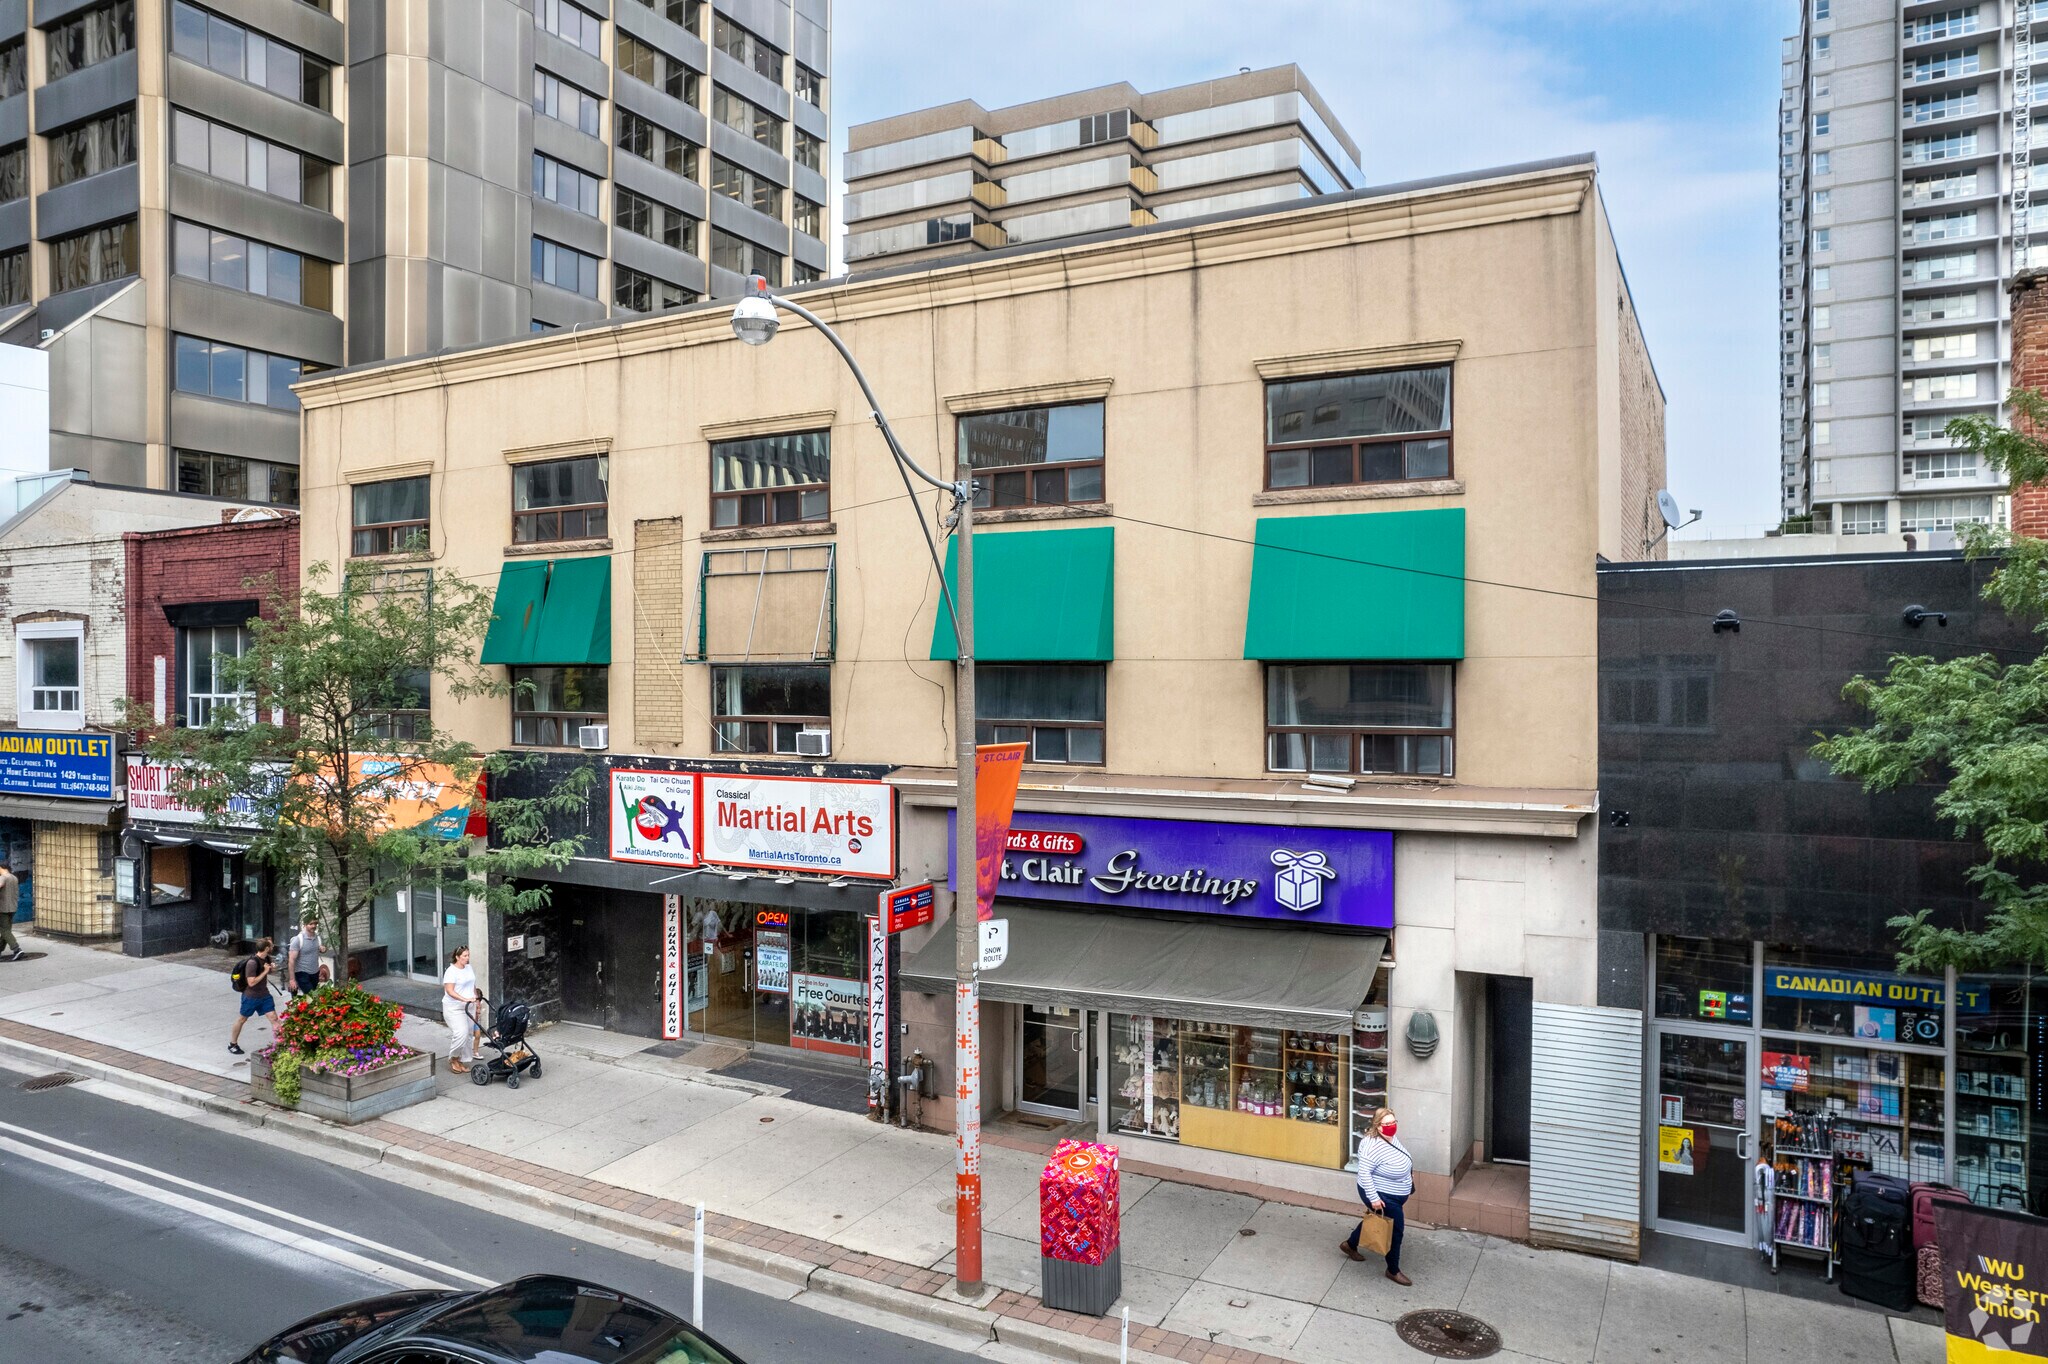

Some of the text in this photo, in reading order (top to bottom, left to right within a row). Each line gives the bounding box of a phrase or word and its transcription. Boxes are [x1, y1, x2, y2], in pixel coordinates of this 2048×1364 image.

[46, 738, 108, 757] OUTLET
[984, 752, 1020, 762] ST. CLAIR
[61, 770, 76, 779] 1429
[128, 764, 161, 791] SHORT
[130, 793, 149, 808] FULLY
[716, 790, 750, 800] Classical
[718, 802, 874, 837] Martial Arts
[1030, 834, 1039, 849] &
[1043, 835, 1074, 850] Gifts
[749, 849, 841, 864] MartialArtsToronto.ca
[1022, 858, 1084, 884] Clair
[1090, 850, 1257, 905] Greetings
[757, 911, 789, 924] OPEN
[668, 926, 677, 958] CHUAN
[985, 946, 1002, 955] SNOW
[983, 955, 1002, 963] ROUTE
[668, 973, 676, 996] CHI
[799, 986, 823, 999] Free
[872, 938, 884, 1049] KARATE
[1776, 975, 1882, 997] CANADIAN
[668, 1001, 677, 1033] GUNG
[1064, 1202, 1079, 1218] S4N
[1069, 1196, 1084, 1213] B2Z
[1060, 1227, 1078, 1250] T9K
[1984, 1256, 2024, 1280] WU
[1975, 1293, 2040, 1323] Union
